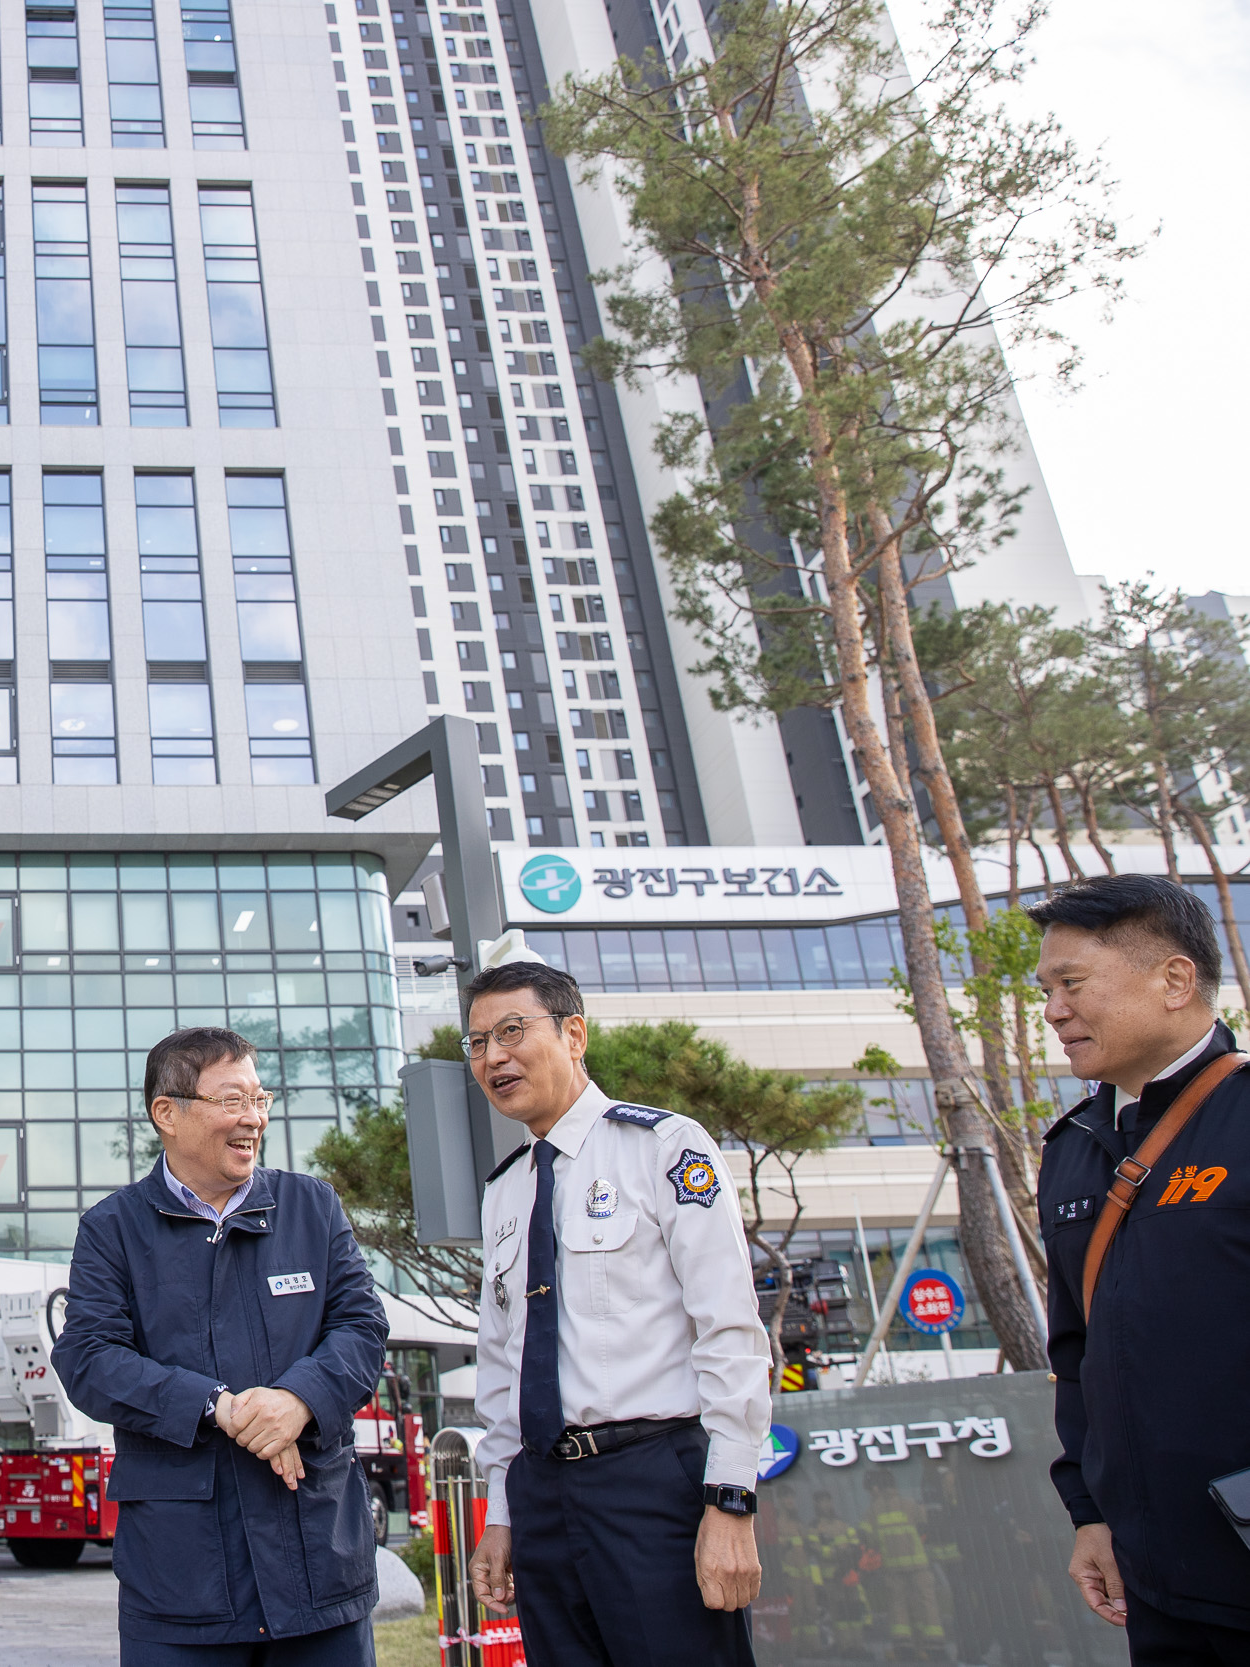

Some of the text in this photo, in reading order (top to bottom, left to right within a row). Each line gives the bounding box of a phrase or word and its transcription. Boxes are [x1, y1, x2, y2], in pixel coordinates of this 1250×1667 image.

[592, 867, 844, 899] 광진구보건소
[692, 1170, 706, 1184] 119
[1169, 1165, 1198, 1180] 소방
[1156, 1166, 1228, 1207] 119
[912, 1286, 949, 1302] 상수도
[914, 1300, 951, 1316] 소화전
[24, 1366, 47, 1380] 119
[808, 1416, 1013, 1467] 광진구청
